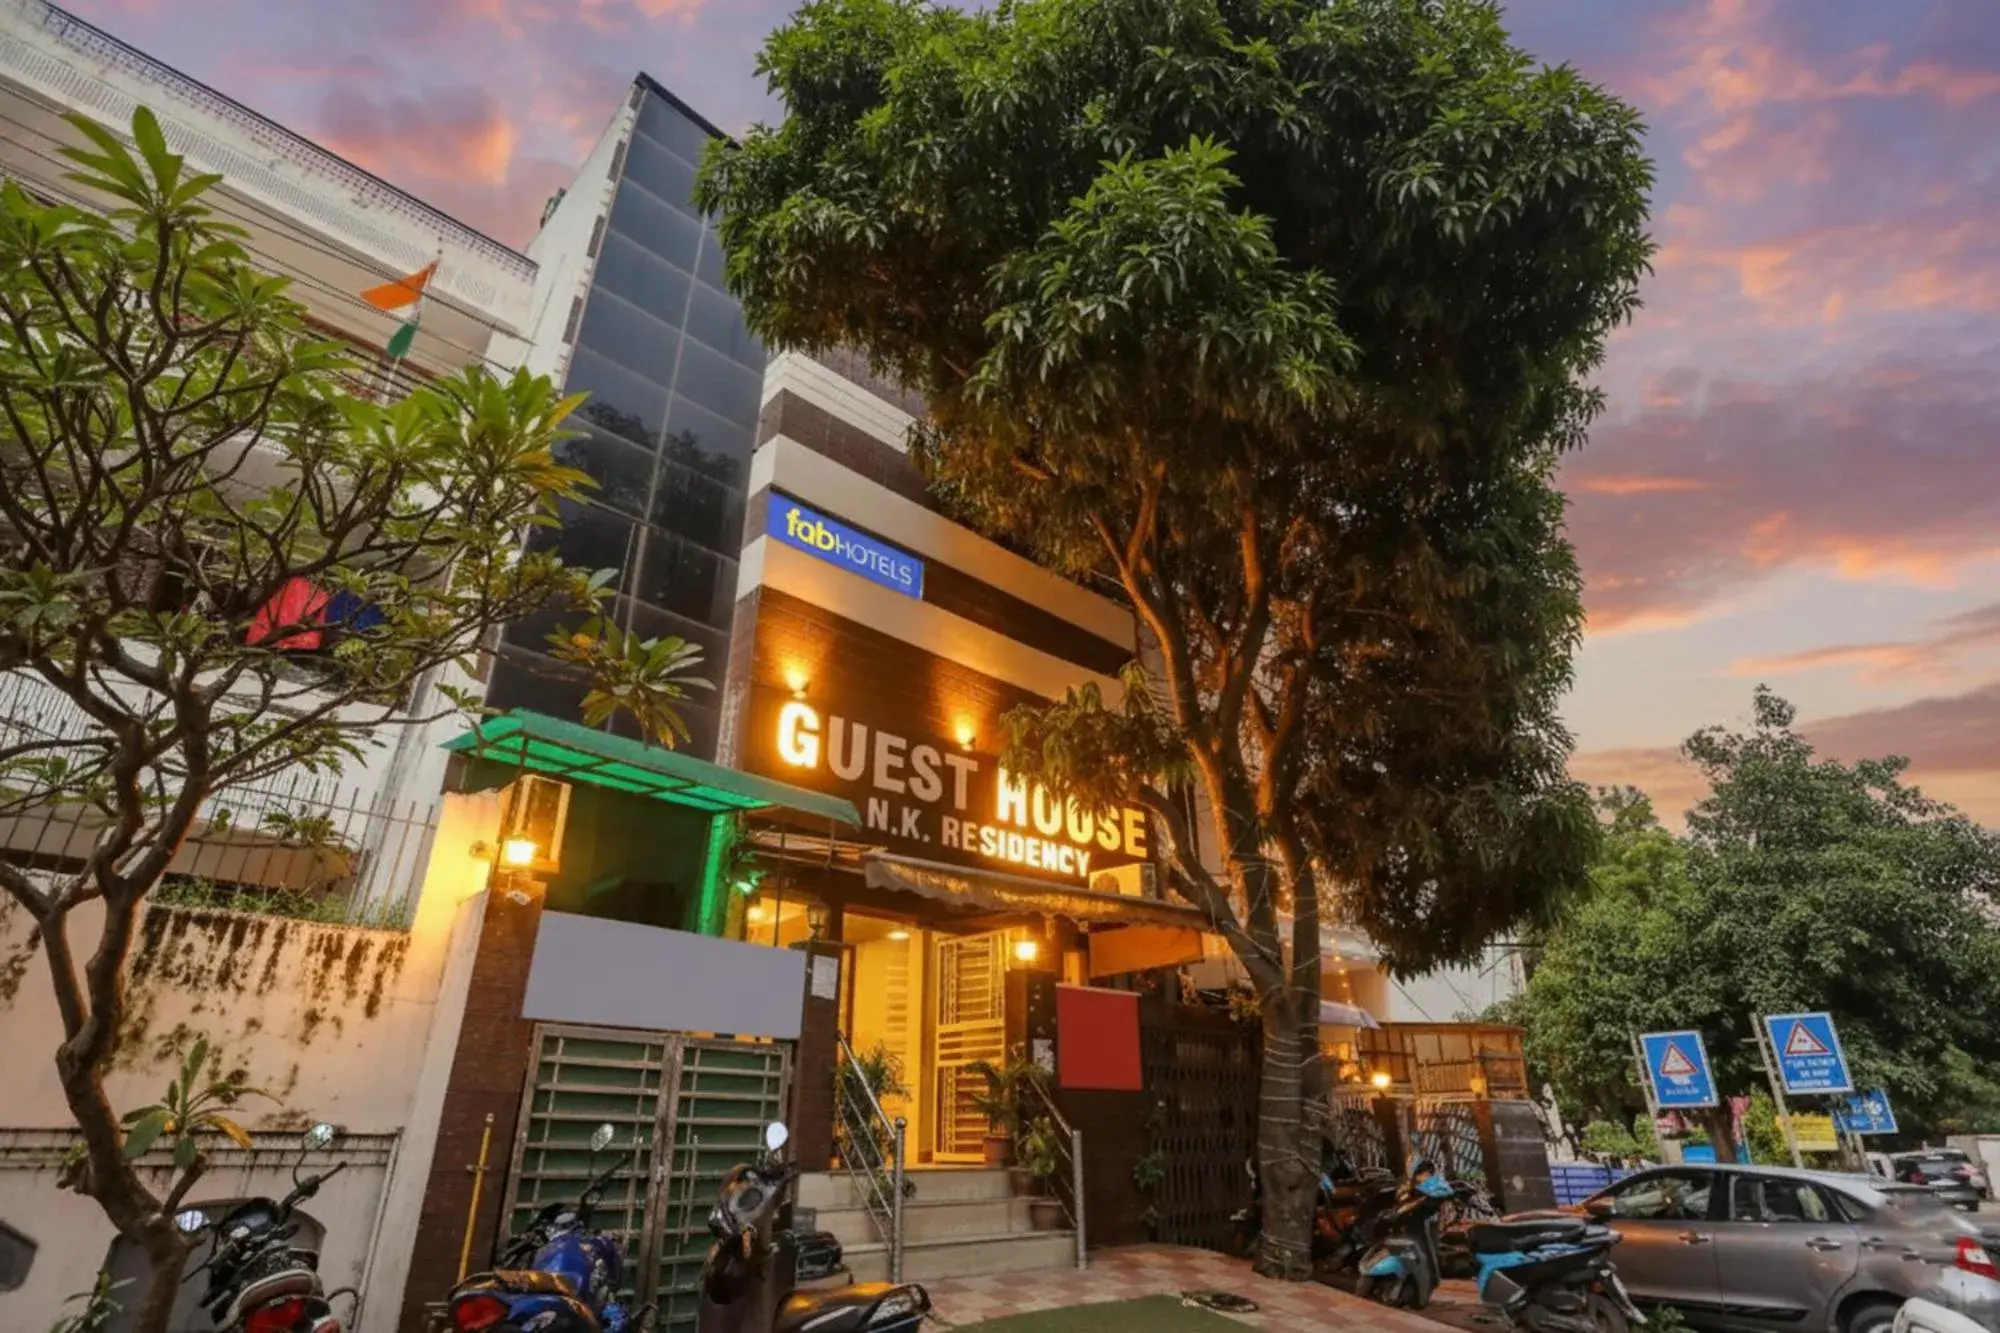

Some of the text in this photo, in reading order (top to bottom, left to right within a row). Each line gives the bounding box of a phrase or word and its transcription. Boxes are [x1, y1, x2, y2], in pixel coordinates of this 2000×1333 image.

[777, 701, 1148, 858] GUEST HOUSE
[867, 796, 1091, 878] N.K. RESIDENCY
